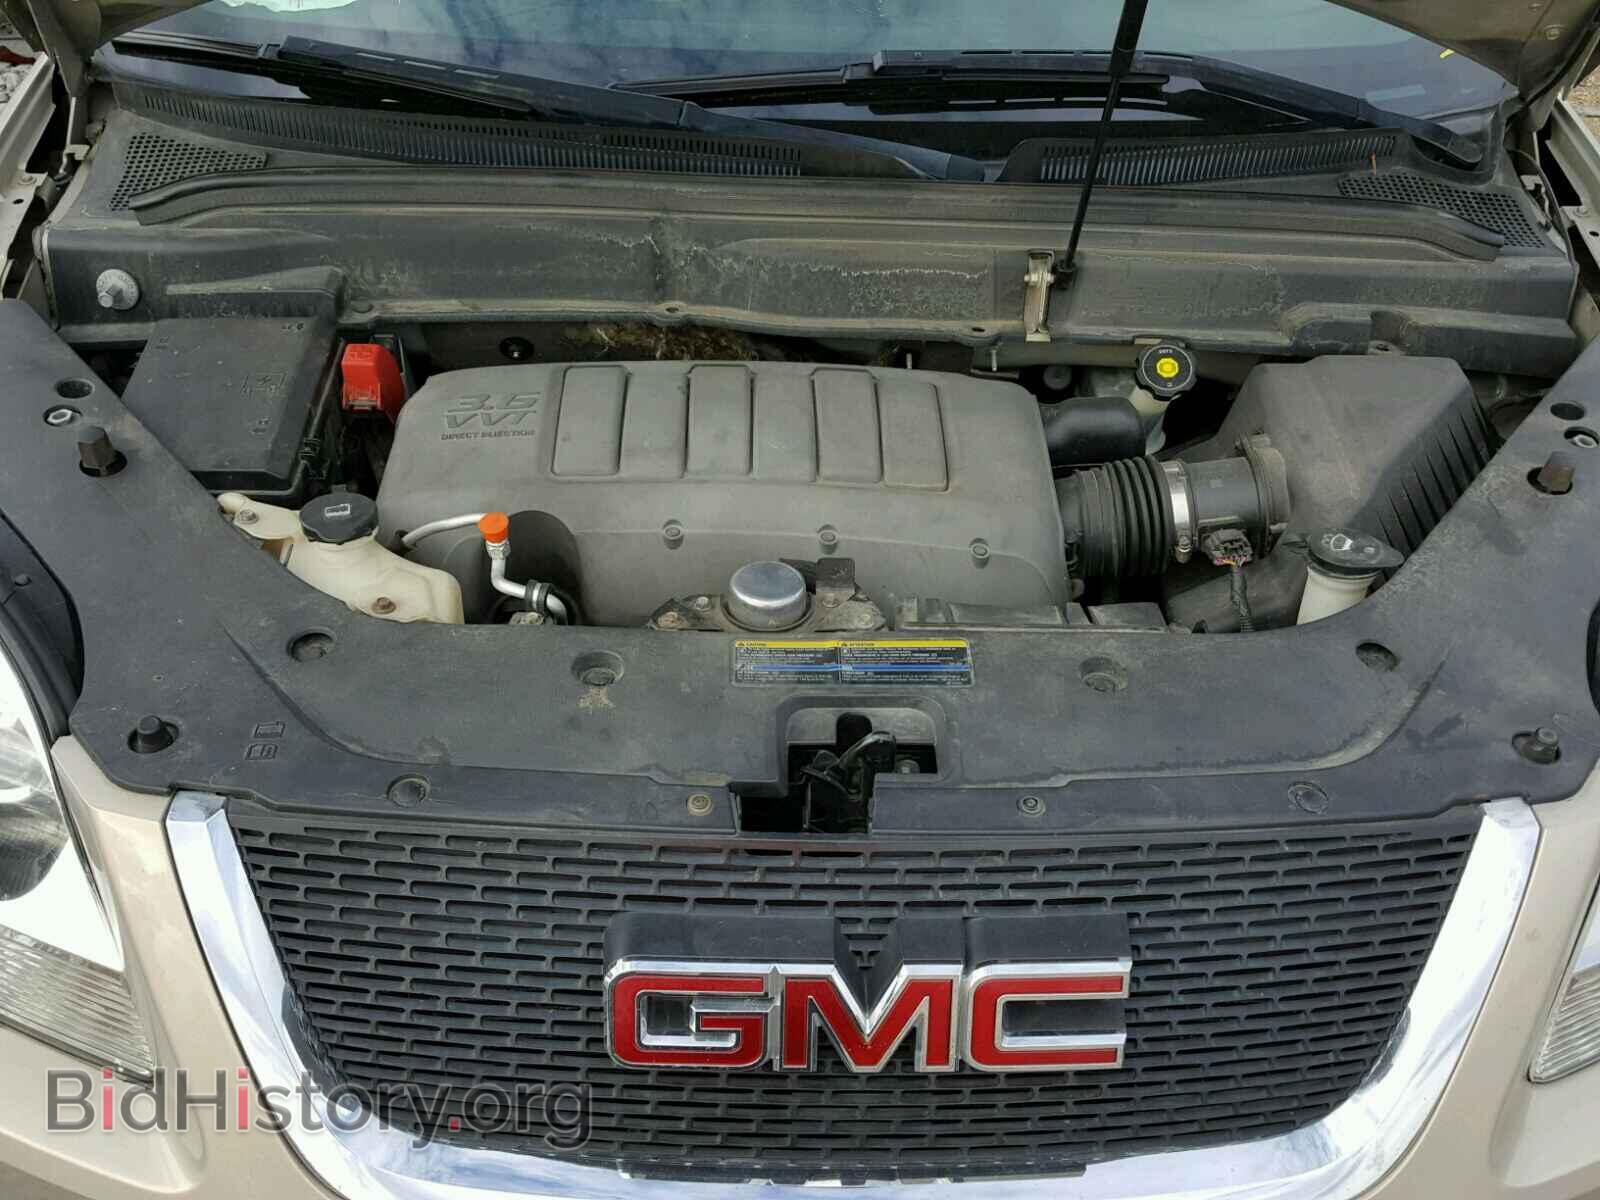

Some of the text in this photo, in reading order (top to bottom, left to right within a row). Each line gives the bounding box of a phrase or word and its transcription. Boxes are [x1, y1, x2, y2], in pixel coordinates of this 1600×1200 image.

[448, 392, 541, 412] 3.6
[446, 410, 537, 429] VVT
[441, 432, 478, 441] DIRECT
[604, 957, 1133, 1073] GMC
